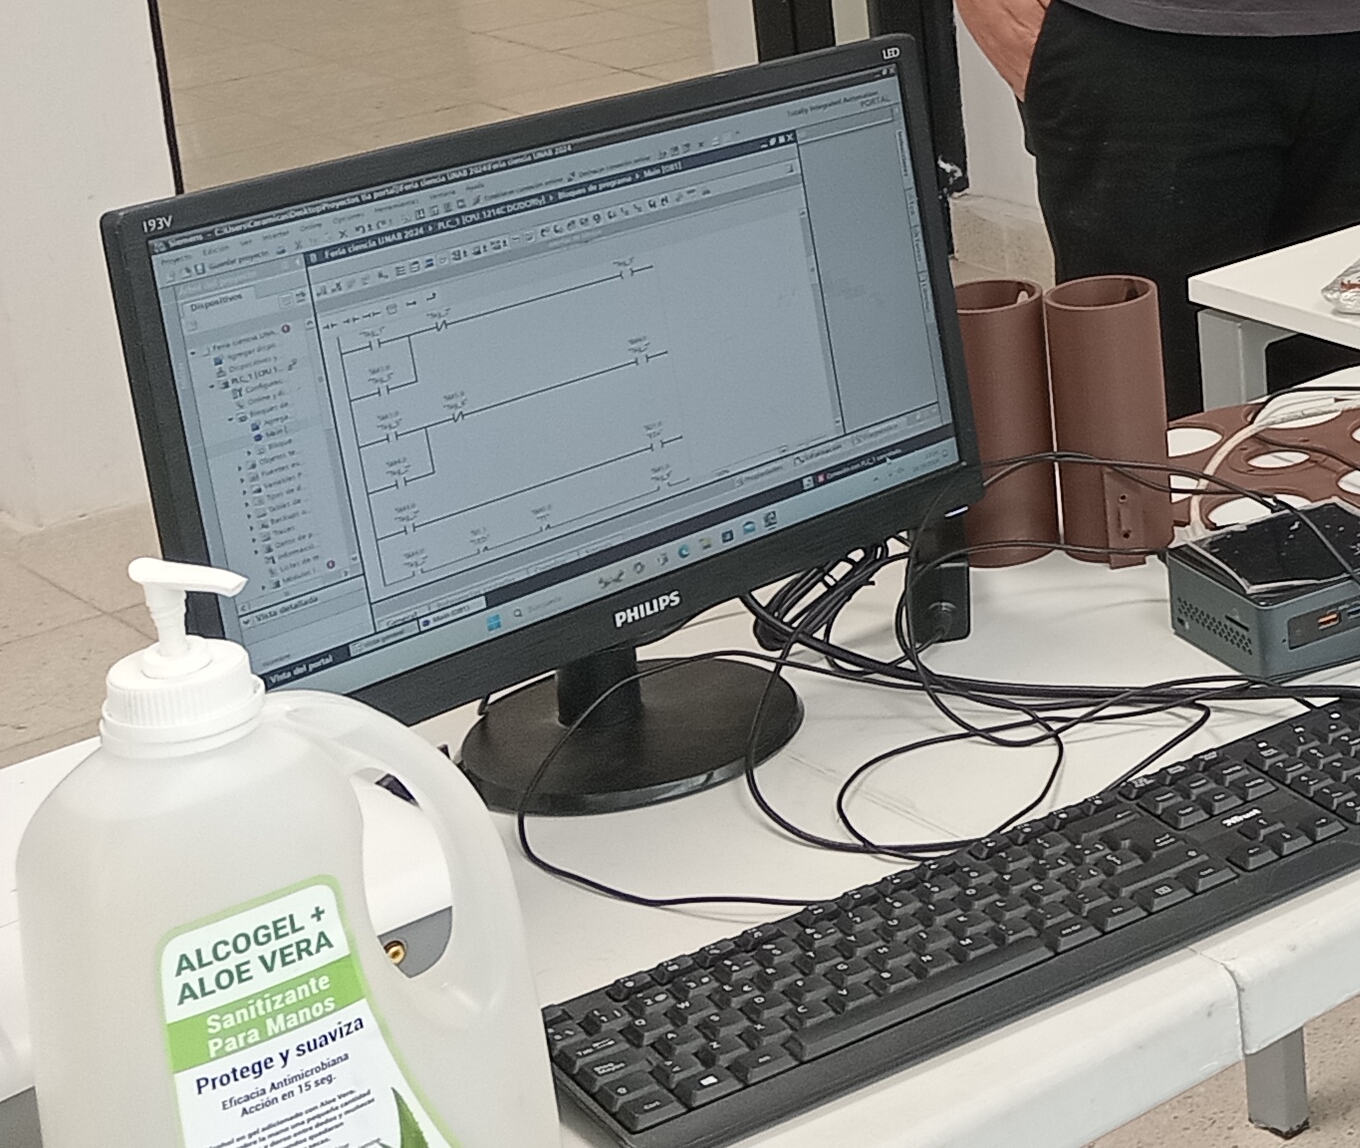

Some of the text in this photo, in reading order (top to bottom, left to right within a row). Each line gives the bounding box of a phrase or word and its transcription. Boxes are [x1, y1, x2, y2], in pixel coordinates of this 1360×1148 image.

[882, 47, 900, 60] LED
[553, 143, 572, 154] 2024
[142, 215, 173, 233] 193V
[377, 231, 403, 246] UNAB
[402, 225, 425, 240] 2024
[189, 290, 243, 313] Dispositivos
[614, 590, 681, 628] PHILIPS
[175, 913, 305, 977] ALCOGEL
[177, 930, 334, 1006] ALOE VERA
[206, 974, 331, 1034] Sanitizante
[208, 997, 336, 1059] Para Manos
[195, 1017, 364, 1096] Protege y suaviza
[221, 1052, 349, 1111] Eficacia Antimicrobiana
[240, 1073, 336, 1118] Acción en 15 seg.
